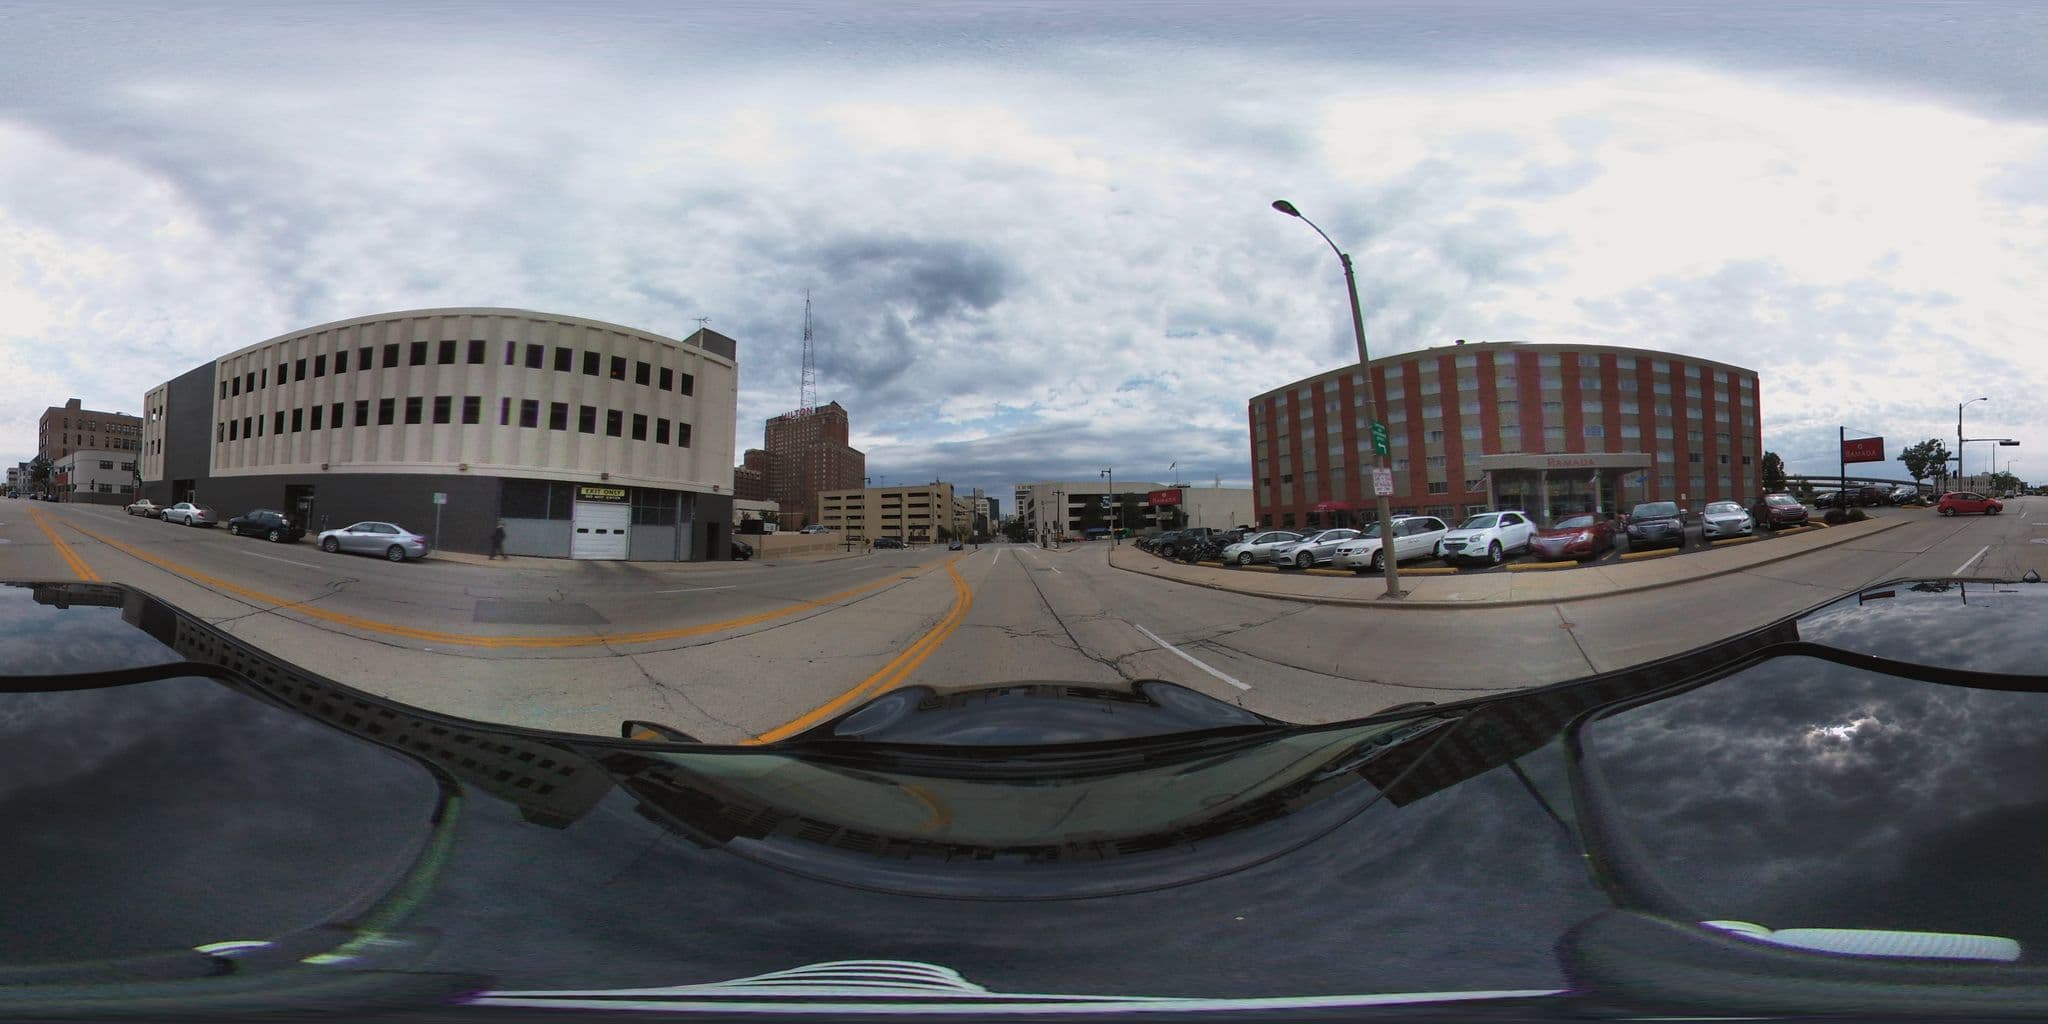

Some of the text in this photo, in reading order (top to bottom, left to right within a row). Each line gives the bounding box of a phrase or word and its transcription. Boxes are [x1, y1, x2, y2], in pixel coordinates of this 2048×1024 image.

[782, 407, 813, 420] HILTON
[1845, 449, 1877, 457] RAMADA
[1547, 457, 1594, 467] RAMADA
